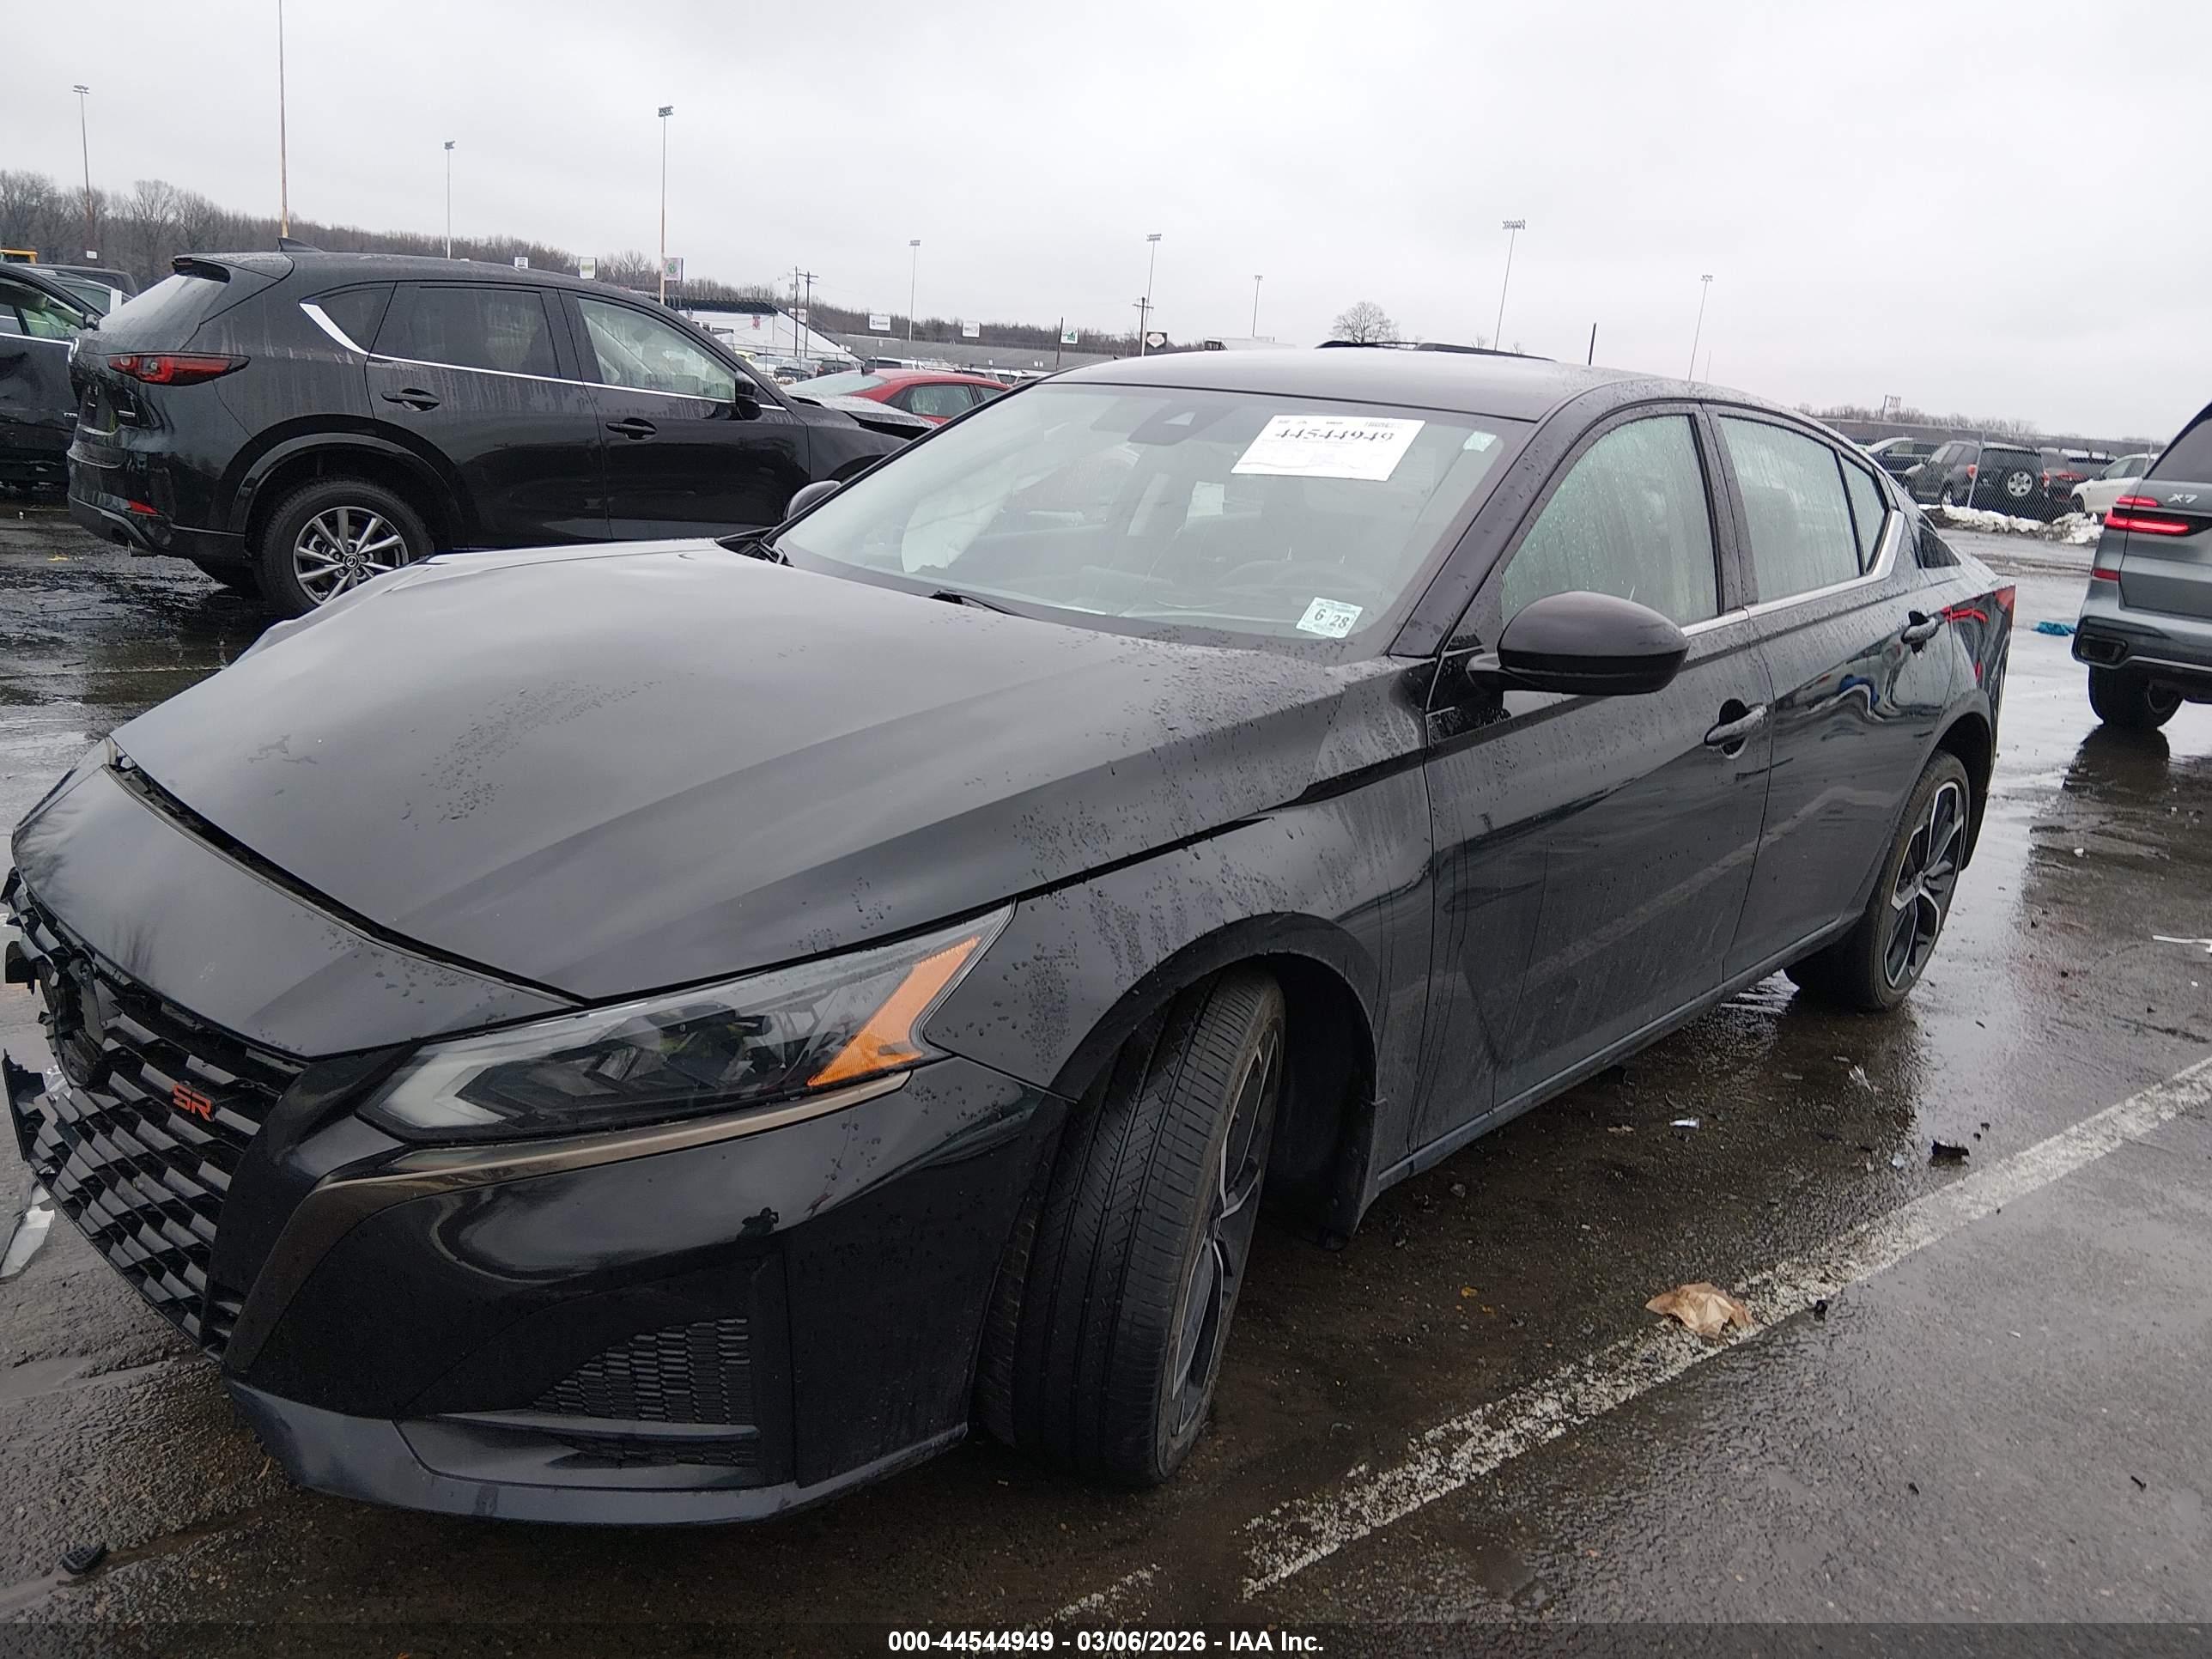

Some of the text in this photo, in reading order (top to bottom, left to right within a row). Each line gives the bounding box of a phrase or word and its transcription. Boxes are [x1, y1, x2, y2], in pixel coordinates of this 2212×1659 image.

[1275, 428, 1395, 441] 44544949
[2168, 493, 2198, 504] X7
[1315, 608, 1350, 629] 6 28
[173, 1085, 211, 1121] SR
